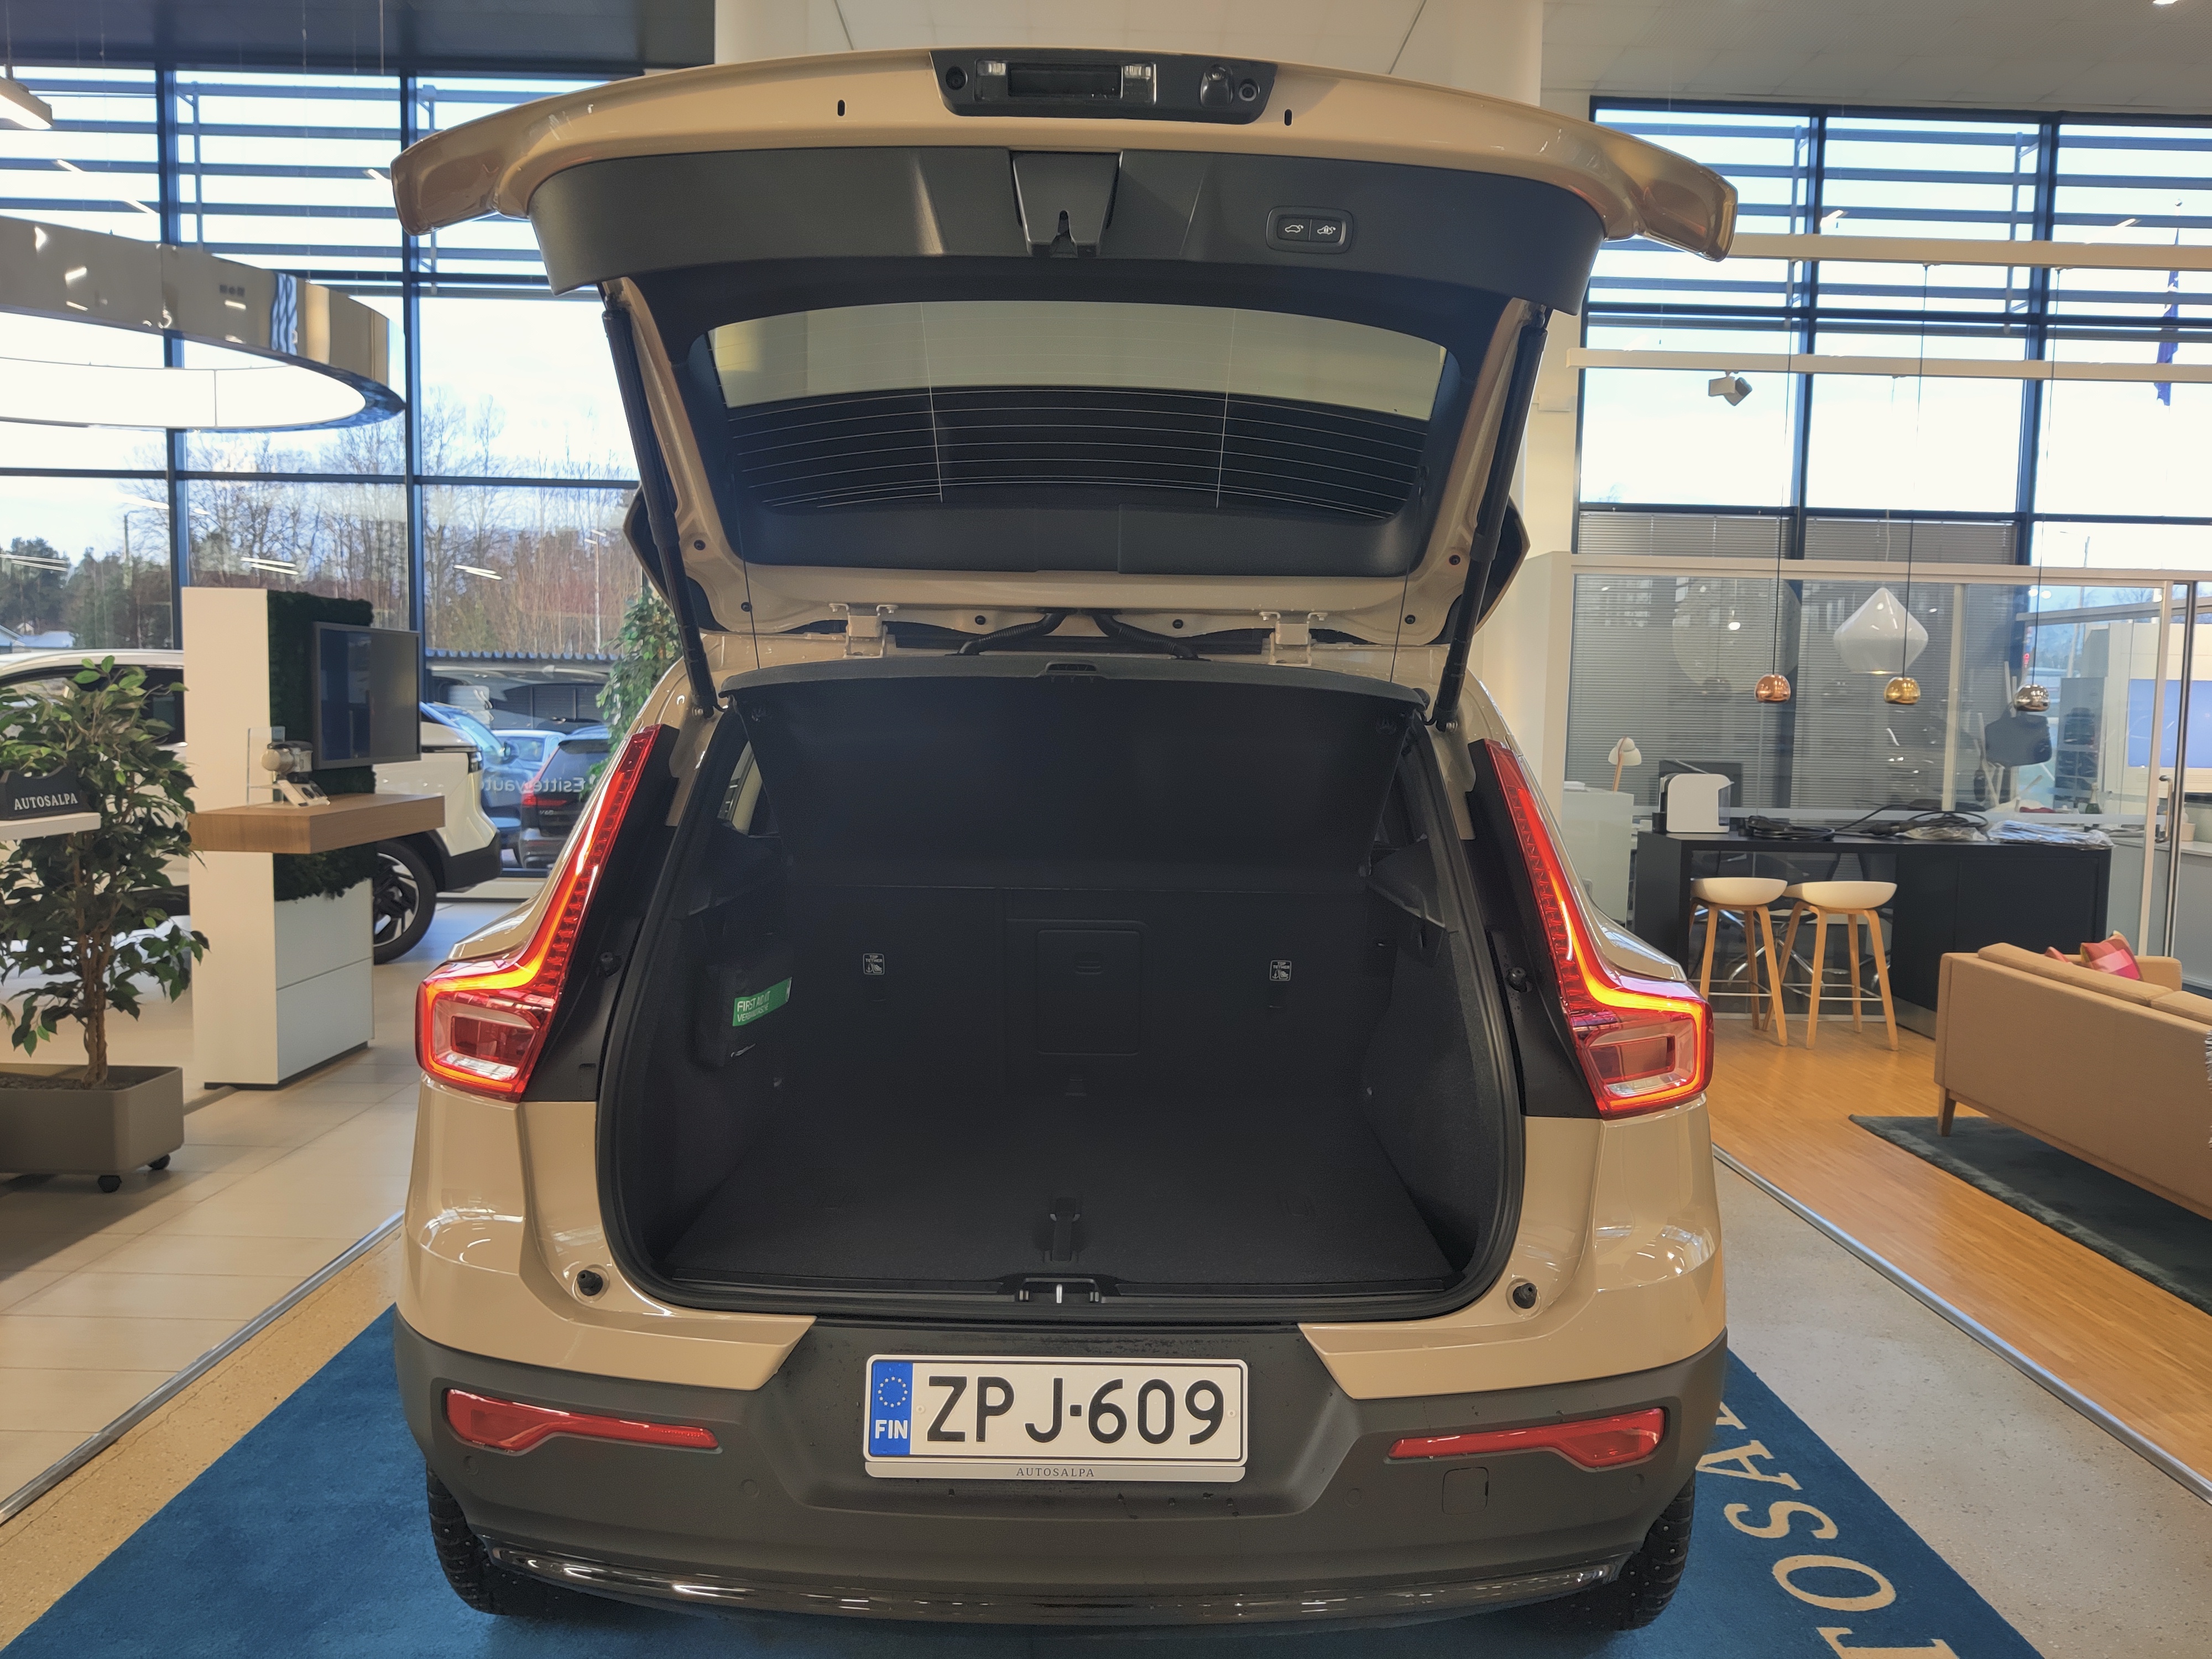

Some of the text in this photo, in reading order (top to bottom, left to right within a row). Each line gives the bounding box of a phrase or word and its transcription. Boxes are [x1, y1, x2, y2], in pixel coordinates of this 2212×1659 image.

[14, 793, 78, 810] AUTOSALPA
[737, 998, 756, 1012] FIRST
[926, 1375, 1224, 1445] ZPJ-609
[875, 1419, 908, 1439] FIN
[1016, 1467, 1094, 1478] AUTOSALPA
